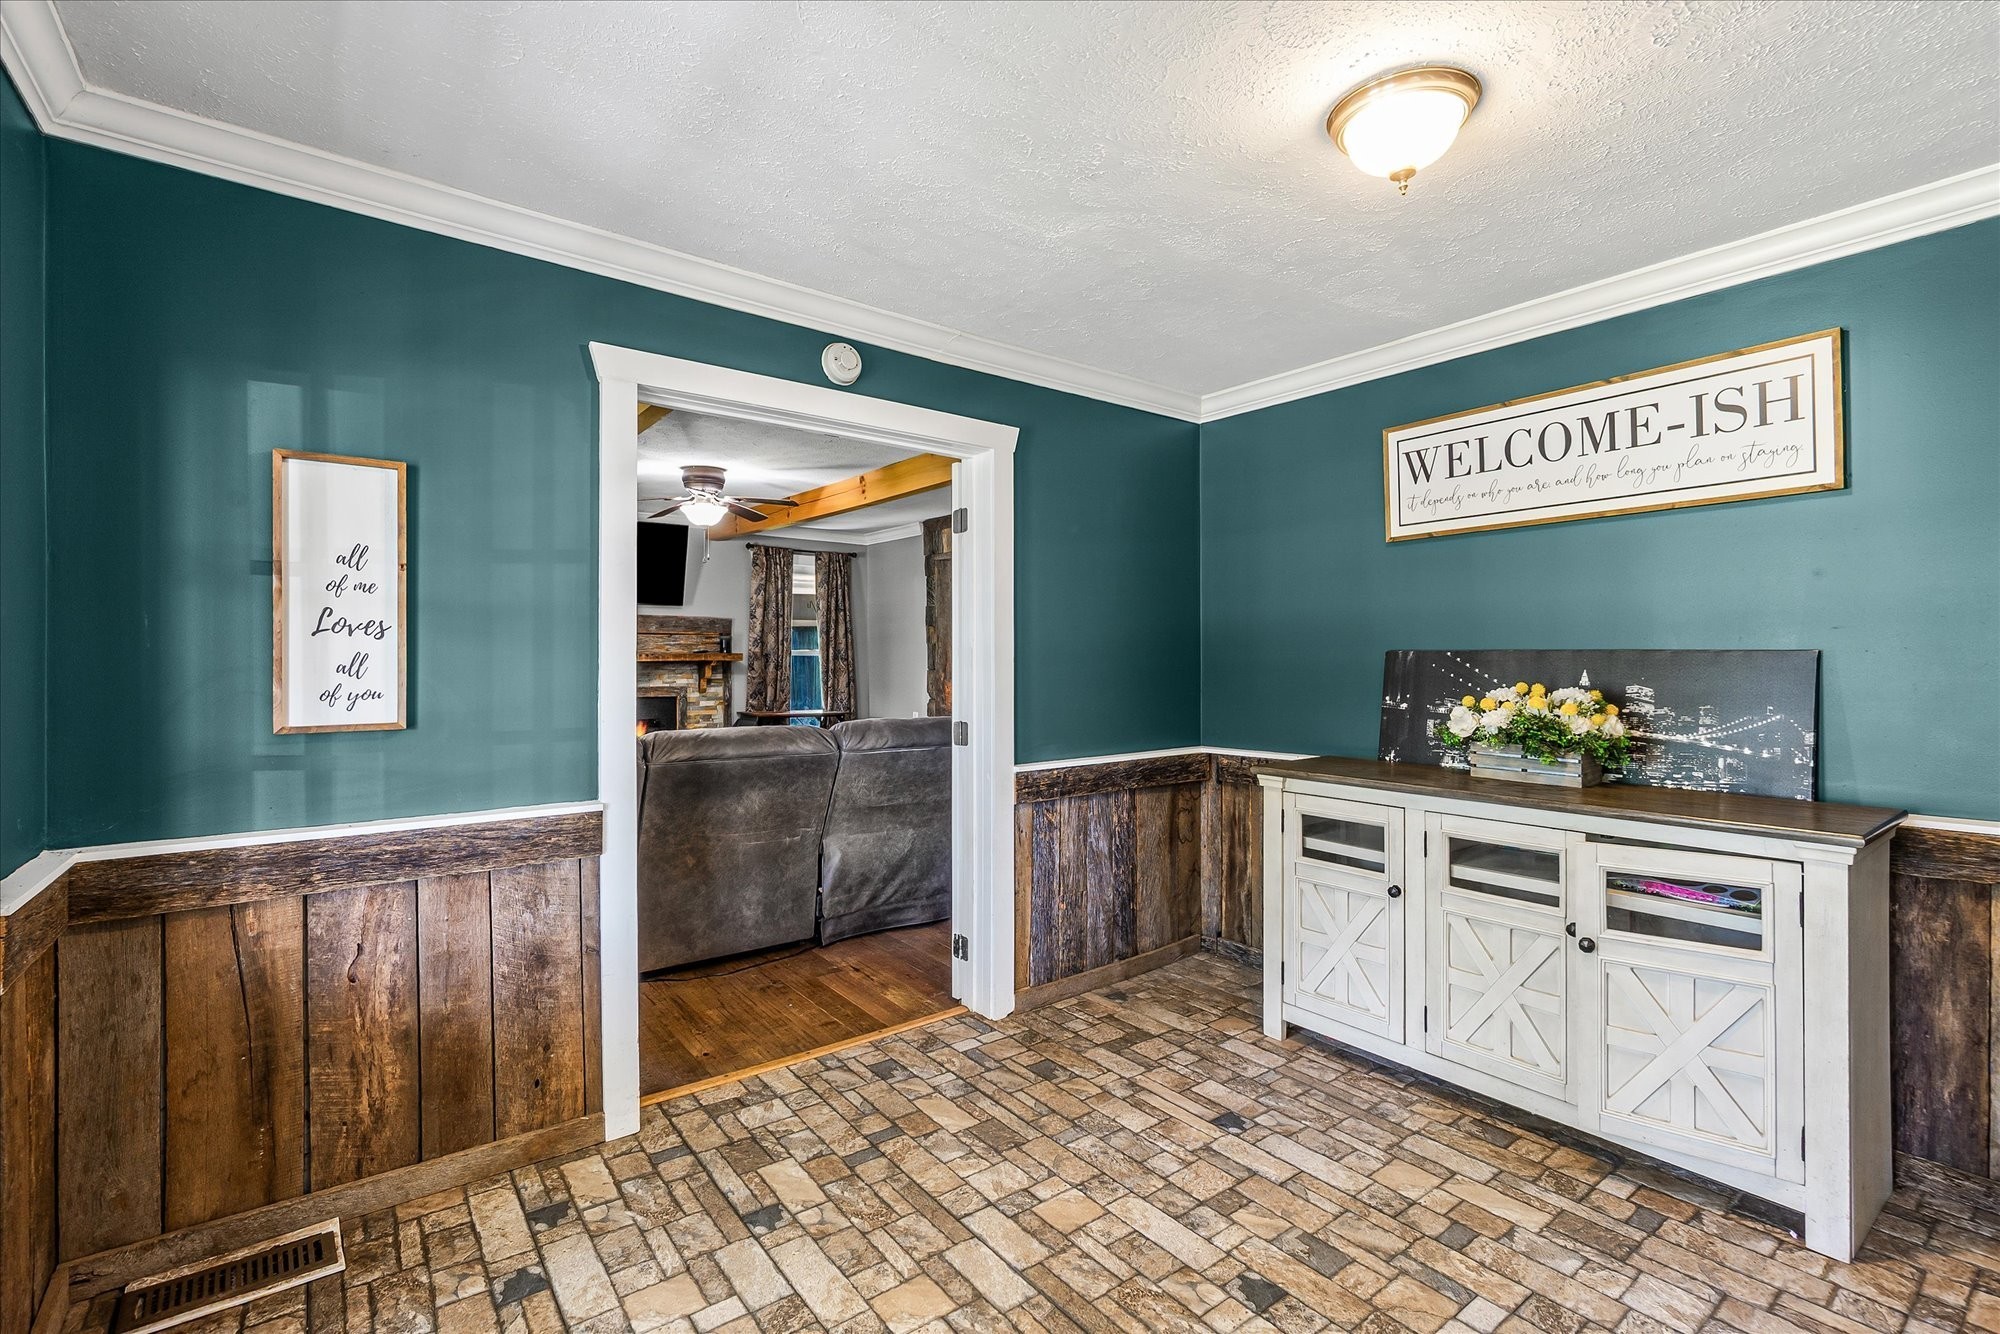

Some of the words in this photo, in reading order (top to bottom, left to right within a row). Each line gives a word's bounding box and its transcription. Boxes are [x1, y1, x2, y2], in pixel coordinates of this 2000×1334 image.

[1402, 374, 1805, 485] WELCOME-ISH
[1407, 494, 1422, 512] it
[1420, 484, 1464, 516] depends
[1467, 491, 1479, 500] on
[1481, 479, 1503, 502] who
[1503, 486, 1524, 504] you
[1555, 465, 1584, 487] and
[1585, 463, 1612, 488] how
[1617, 454, 1646, 489] long
[1646, 464, 1672, 485] you
[1673, 443, 1716, 483] plan
[1720, 454, 1736, 462] on
[336, 543, 369, 571] all
[326, 574, 348, 598] of
[353, 582, 378, 594] me
[311, 606, 393, 641] Loves
[336, 651, 369, 680] all
[319, 683, 342, 708] of
[346, 688, 384, 712] you
